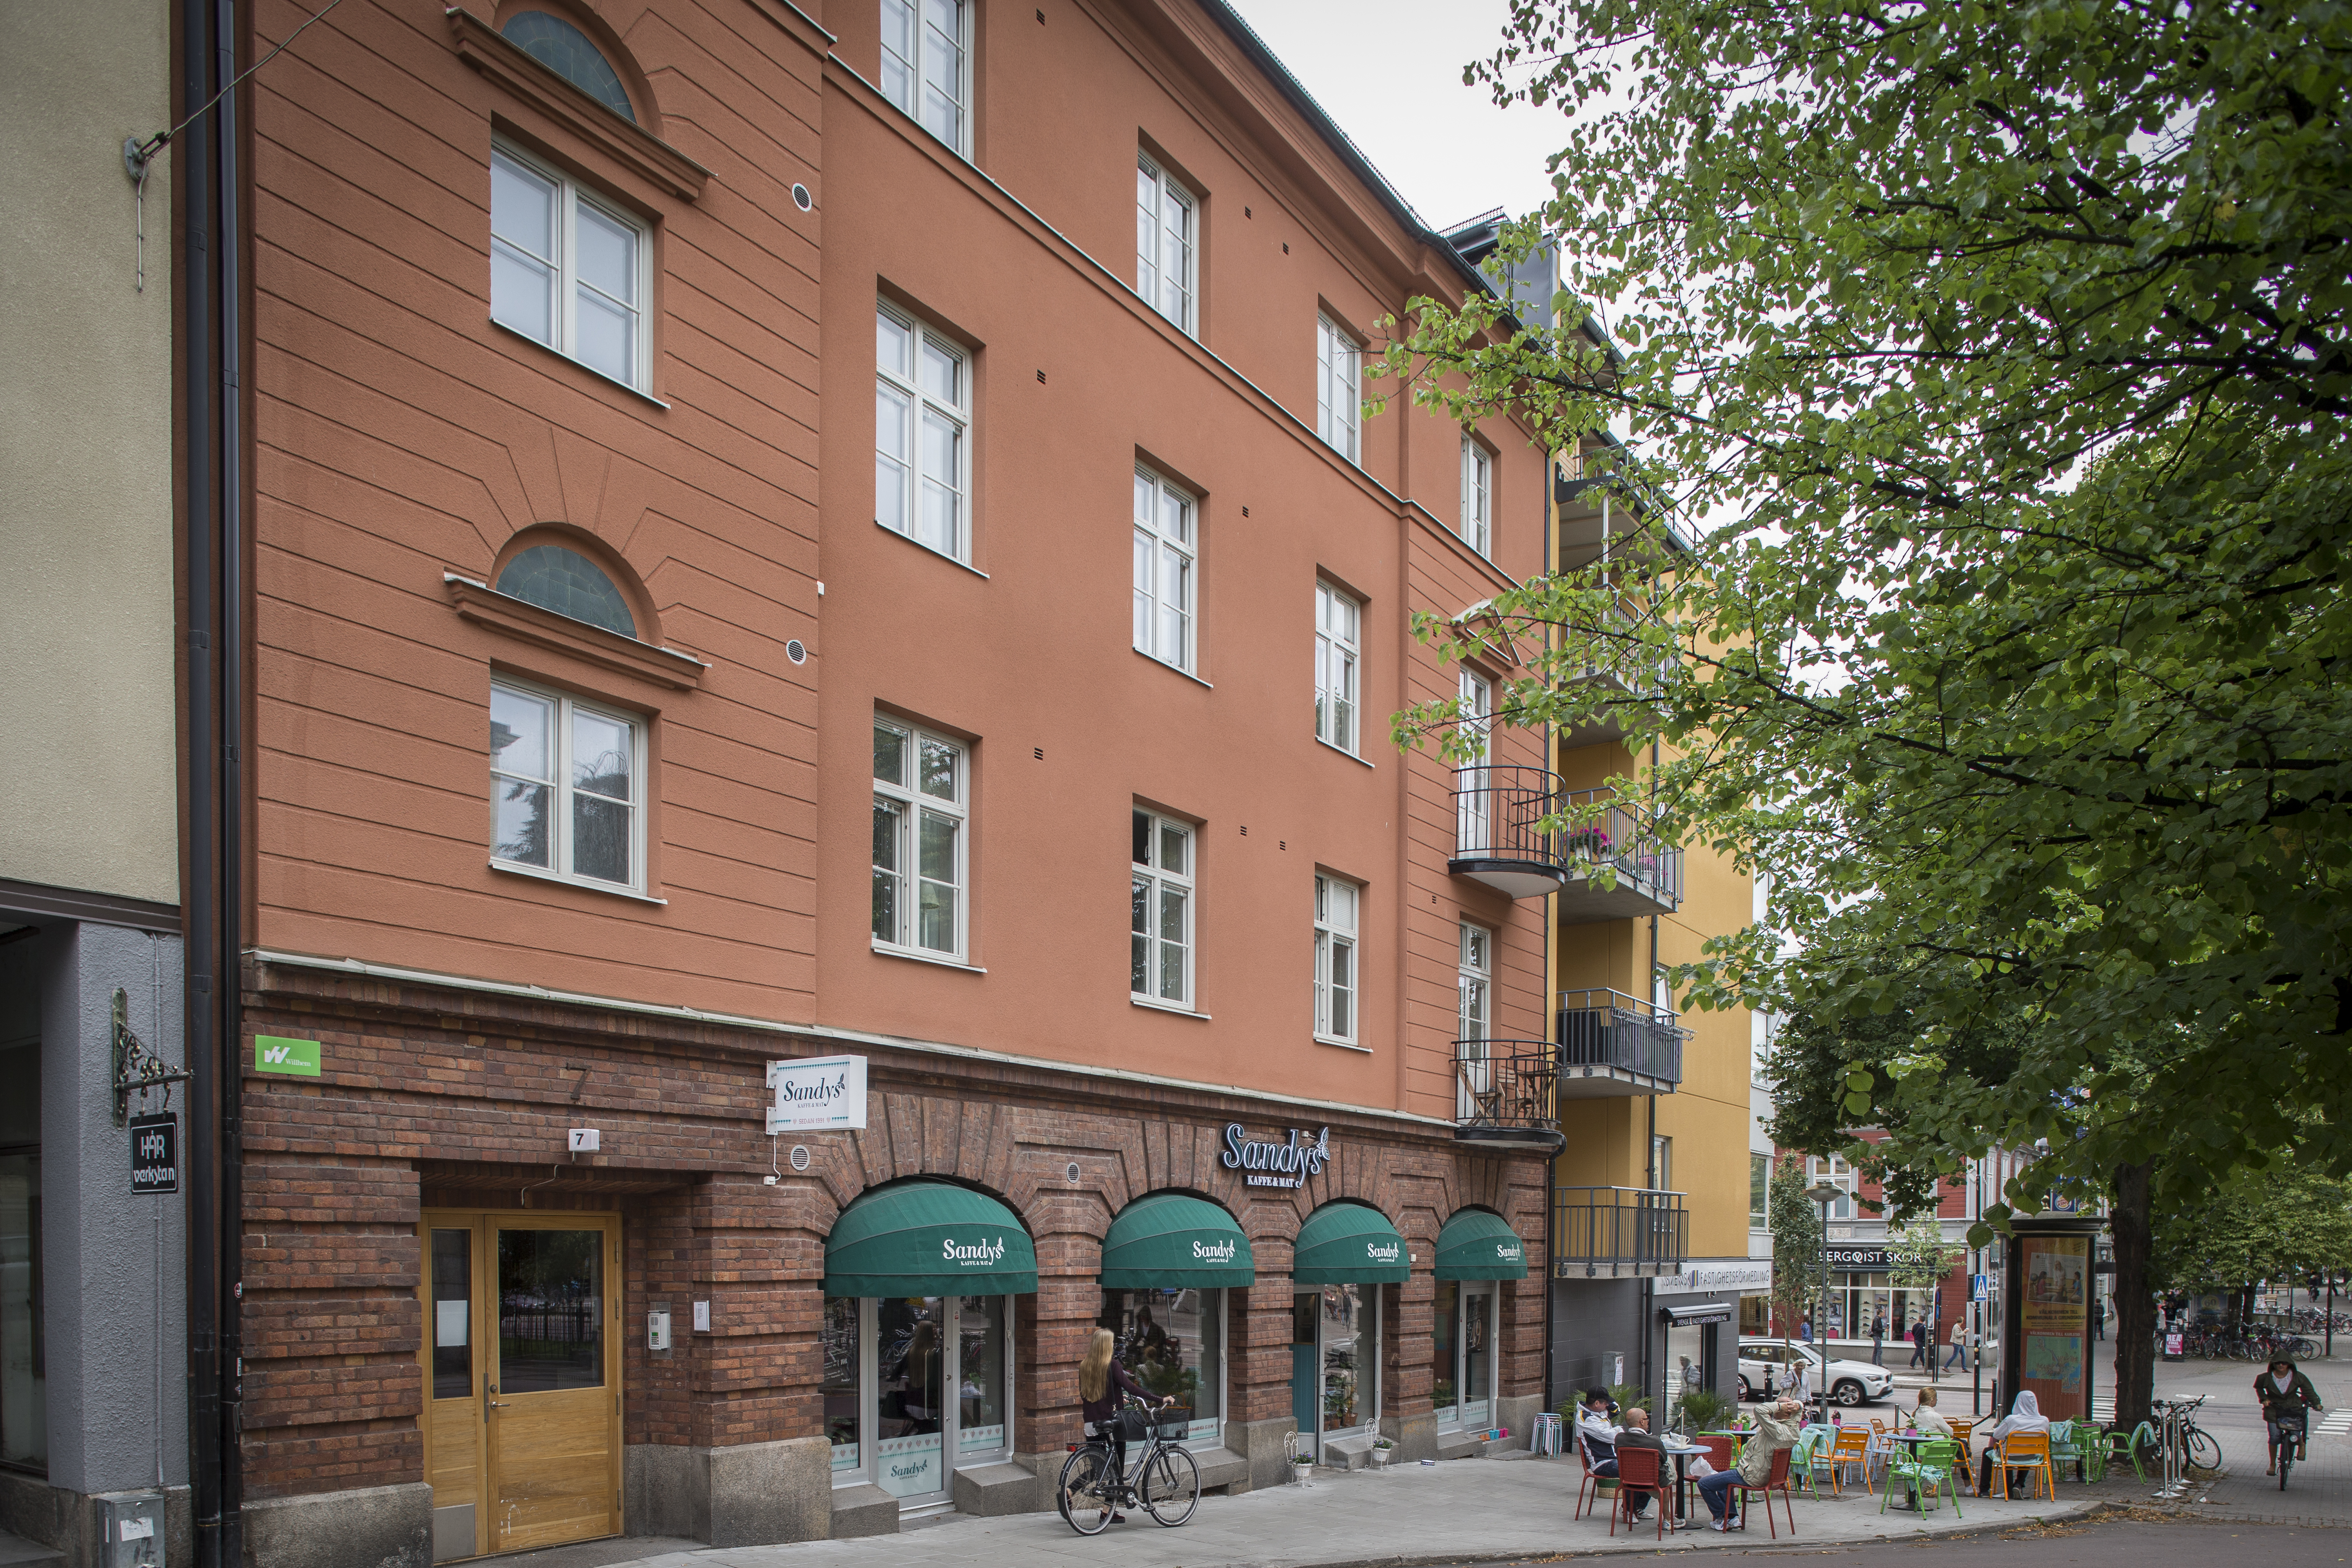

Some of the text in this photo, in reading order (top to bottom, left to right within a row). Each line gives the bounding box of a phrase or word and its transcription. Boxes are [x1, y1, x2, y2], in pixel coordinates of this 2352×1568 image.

[286, 1058, 312, 1067] Willhem
[784, 1078, 841, 1106] Sandys
[576, 1133, 584, 1145] 7
[1222, 1123, 1322, 1188] Sandys
[133, 1165, 175, 1185] verkstan
[1247, 1175, 1294, 1187] KAFFE & MAT
[943, 1238, 1001, 1266] Sandys
[1193, 1240, 1233, 1263] Sandys
[1367, 1243, 1398, 1262] Sandys
[1497, 1244, 1520, 1261] Sandys
[1664, 1268, 1770, 1287] SVENSK FASTIGHETSFÖRMEDLING
[1692, 1315, 1727, 1324] FASTIGHETSFÖRMEDLING
[891, 1462, 924, 1477] Sandys
